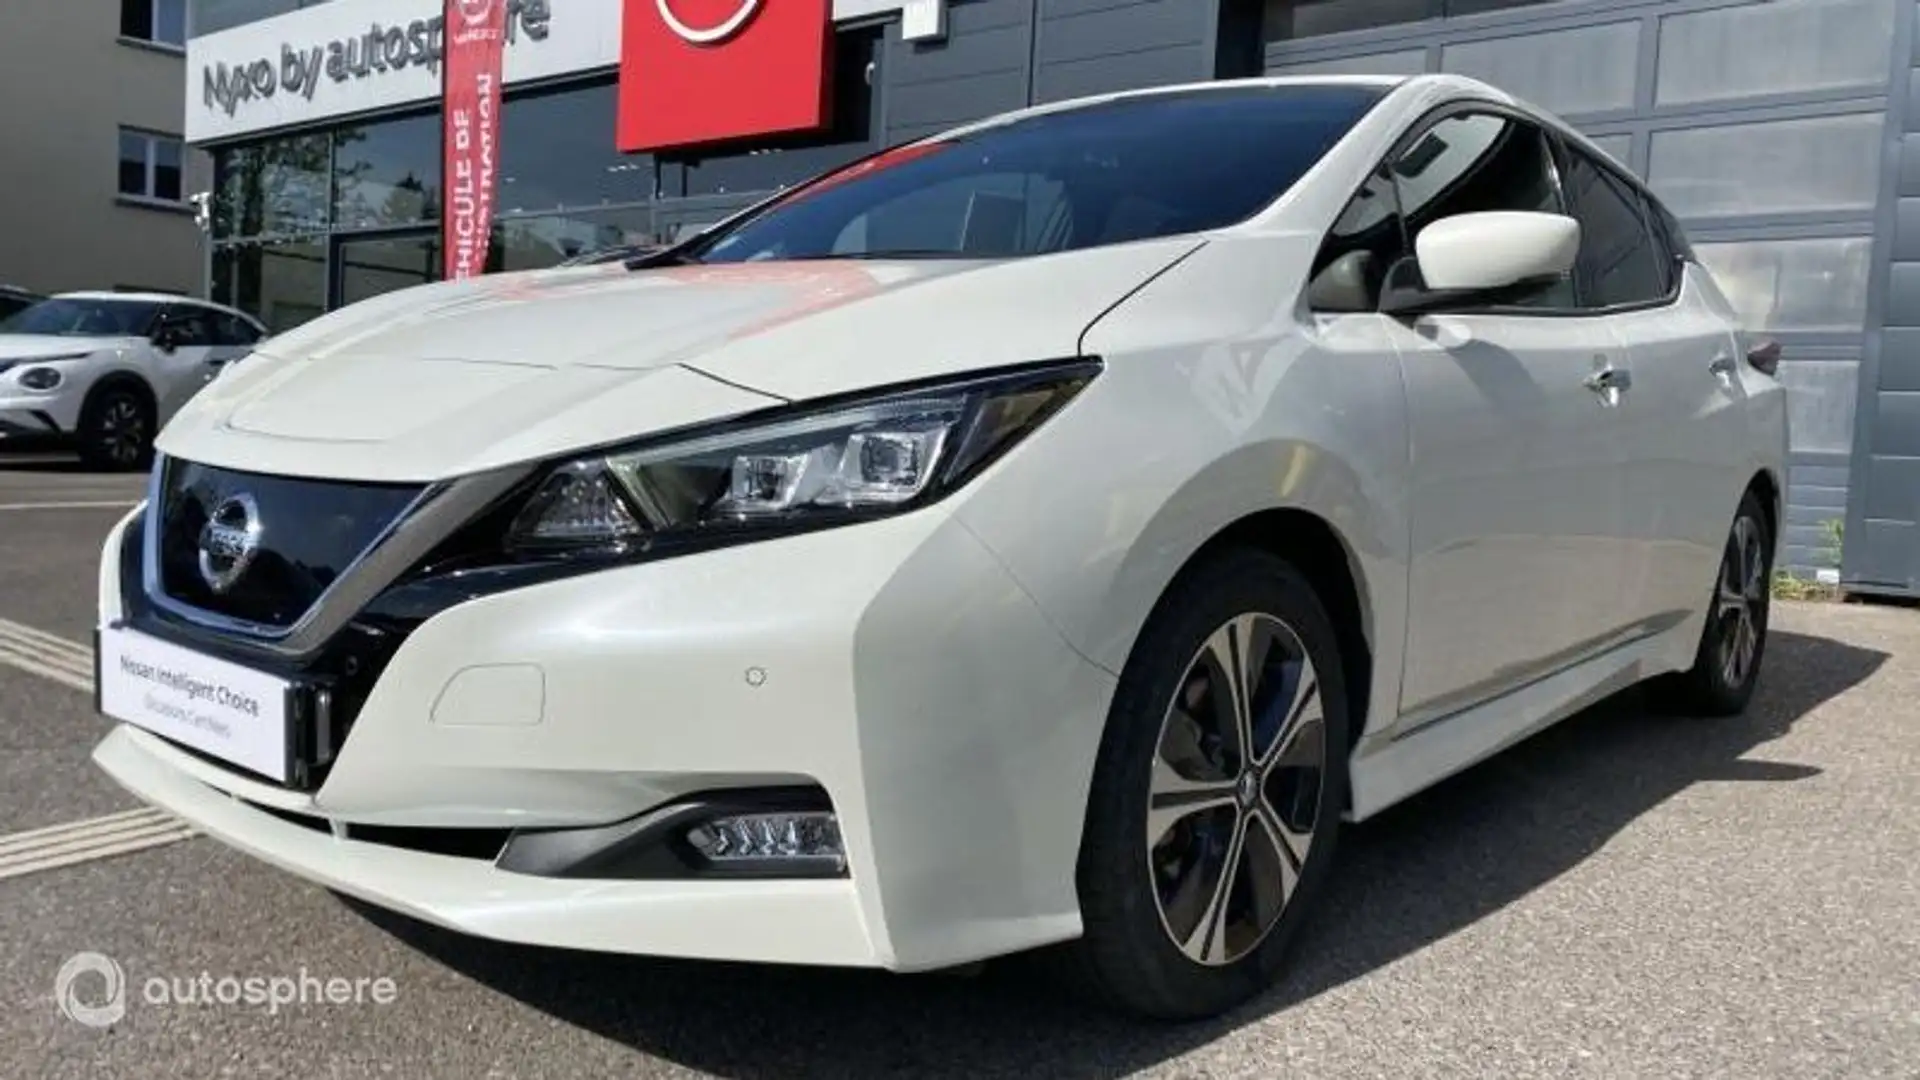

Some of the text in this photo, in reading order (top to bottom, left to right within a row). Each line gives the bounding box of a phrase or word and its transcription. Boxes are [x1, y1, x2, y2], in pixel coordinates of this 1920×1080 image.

[281, 42, 323, 103] by
[326, 0, 551, 84] autospre
[452, 107, 471, 152] DE
[216, 684, 260, 718] Choice
